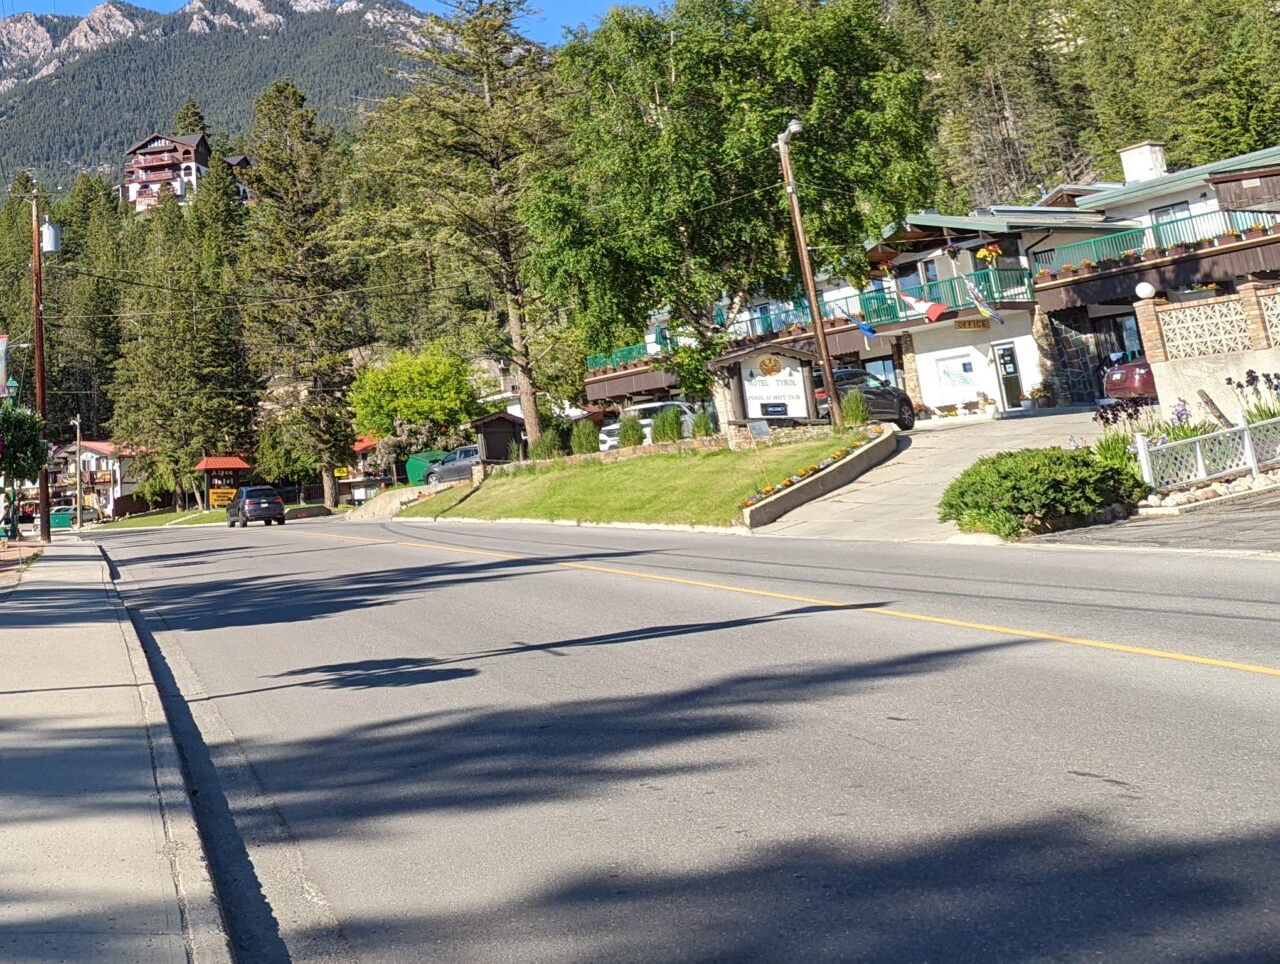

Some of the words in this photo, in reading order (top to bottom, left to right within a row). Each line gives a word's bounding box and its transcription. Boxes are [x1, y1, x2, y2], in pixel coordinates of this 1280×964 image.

[958, 320, 987, 328] OFFICE
[748, 379, 769, 387] MOTEL
[776, 379, 797, 387] TYROL
